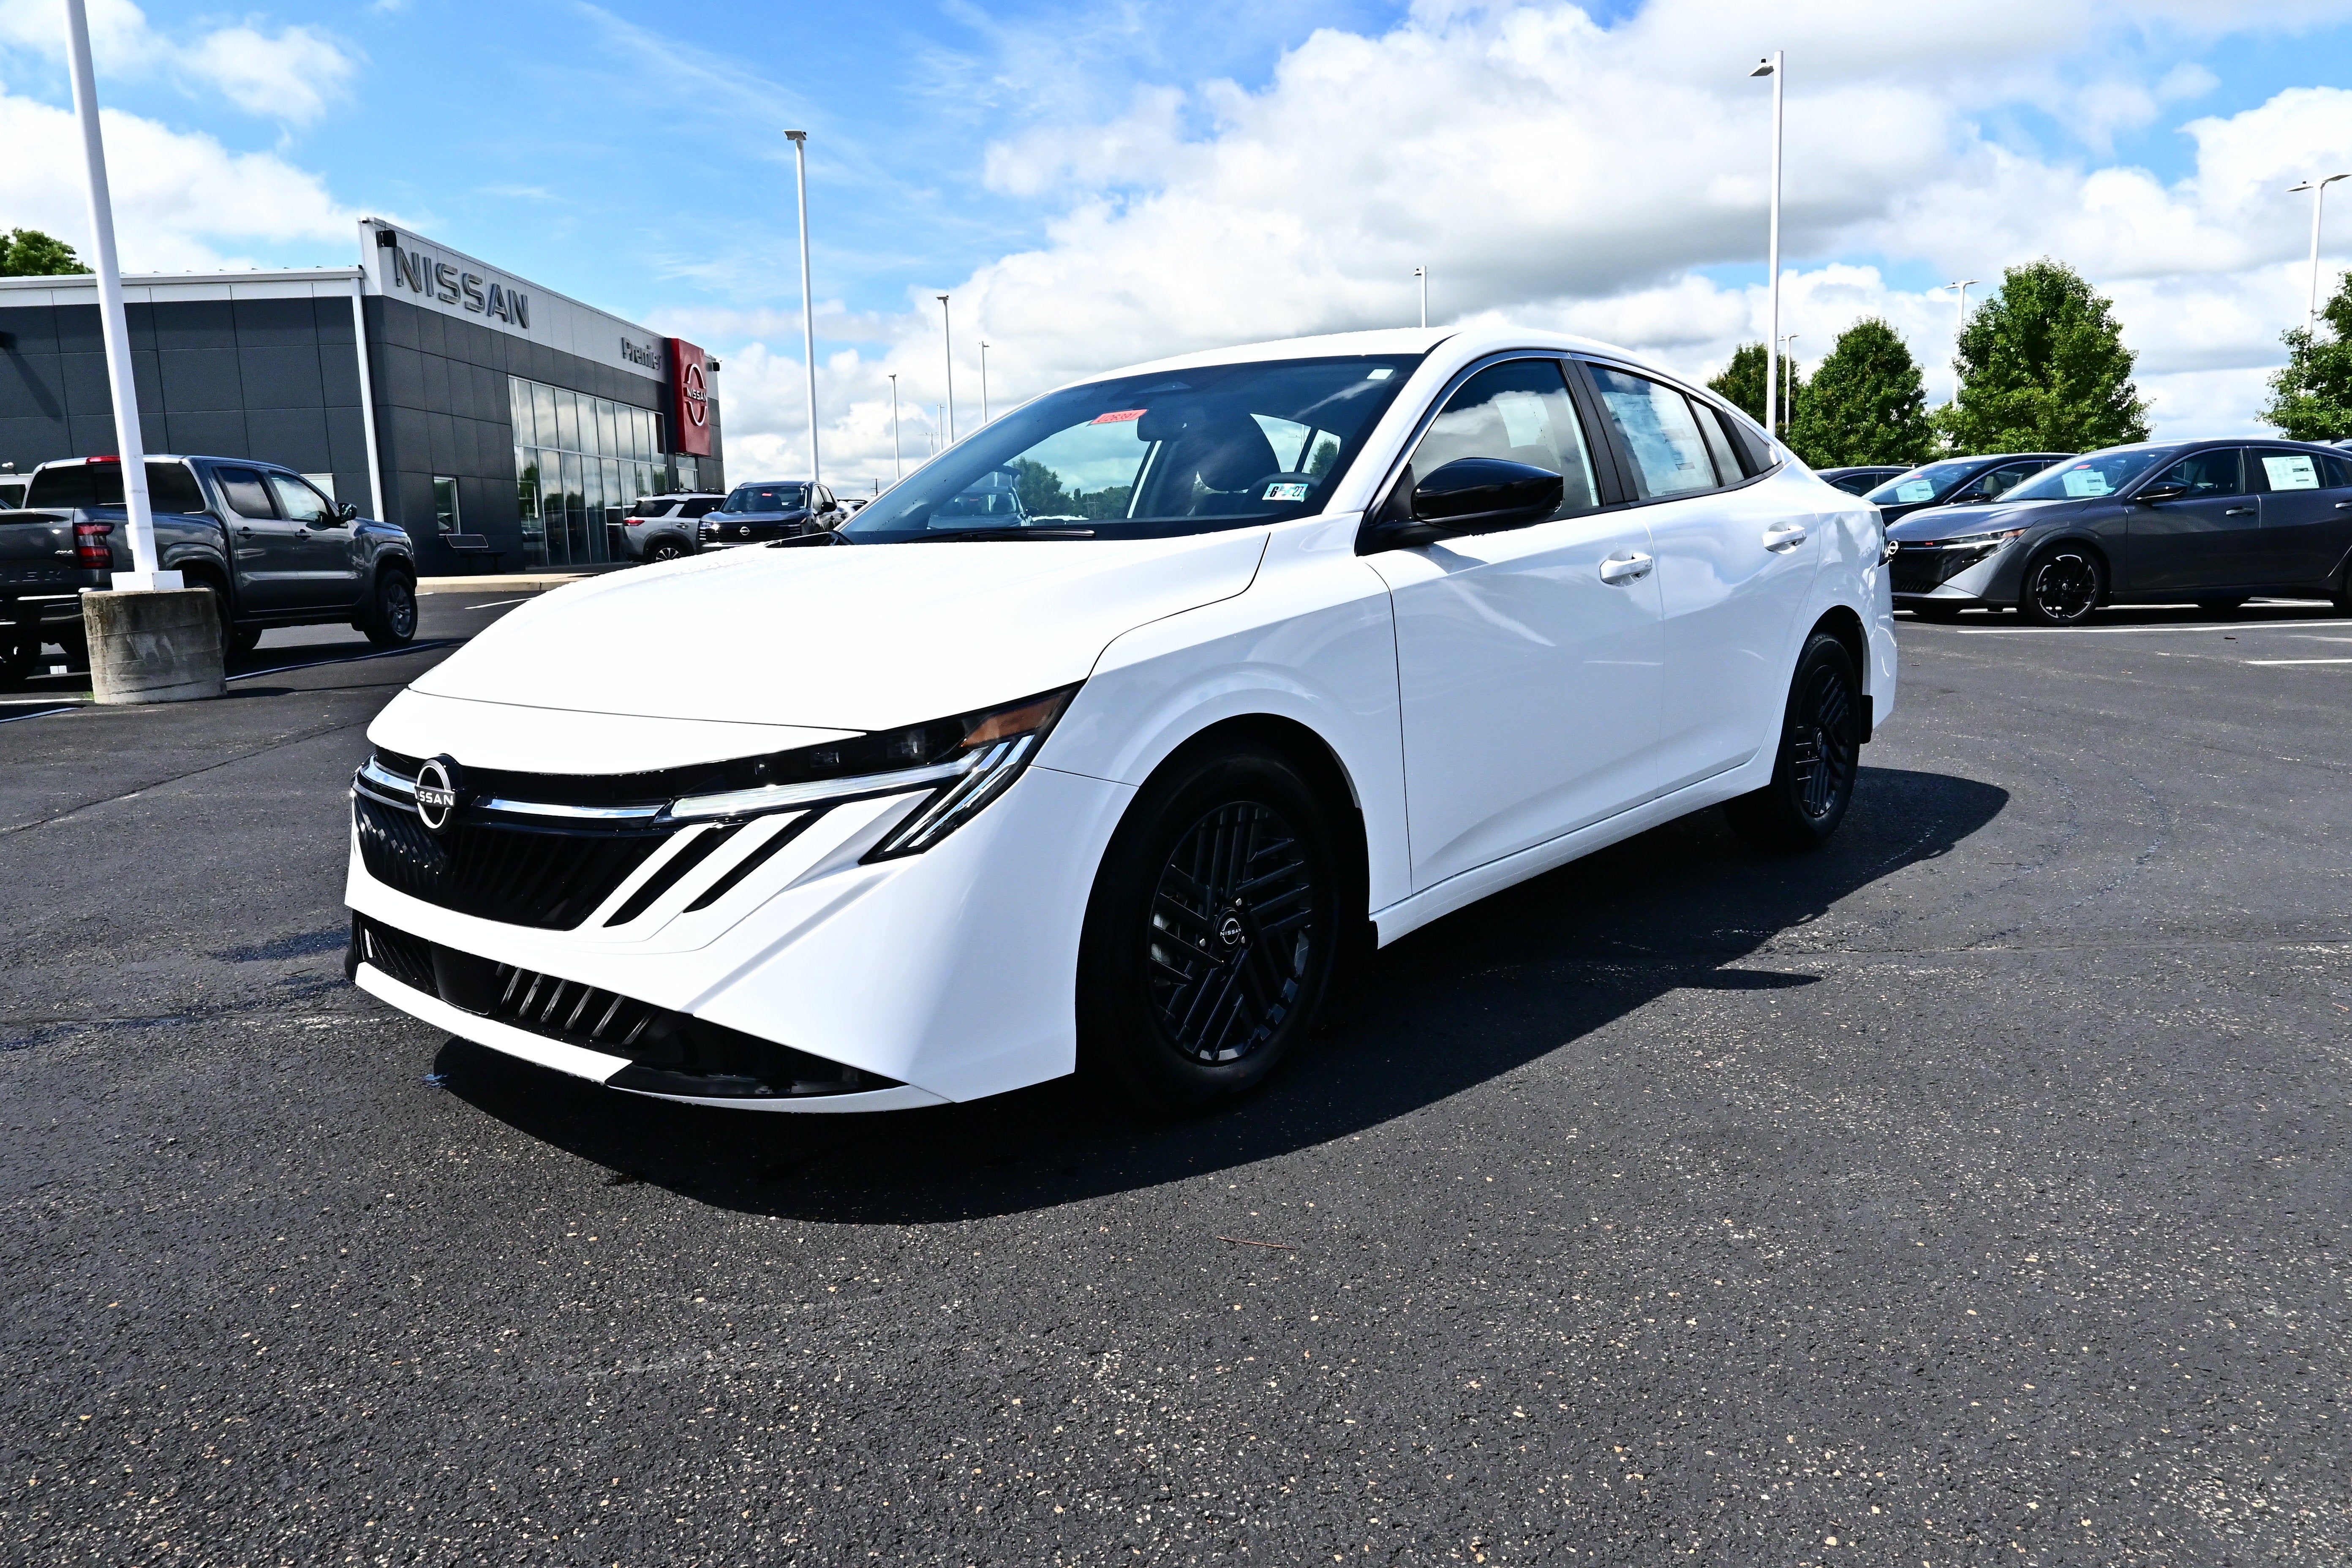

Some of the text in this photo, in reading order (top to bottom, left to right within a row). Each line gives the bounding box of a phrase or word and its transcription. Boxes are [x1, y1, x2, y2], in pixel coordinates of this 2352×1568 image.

[393, 246, 530, 329] NISSAN
[622, 337, 662, 370] Premier
[687, 387, 707, 402] NISSAN
[1269, 486, 1304, 497] 6 27
[1220, 928, 1241, 936] NISSAN
